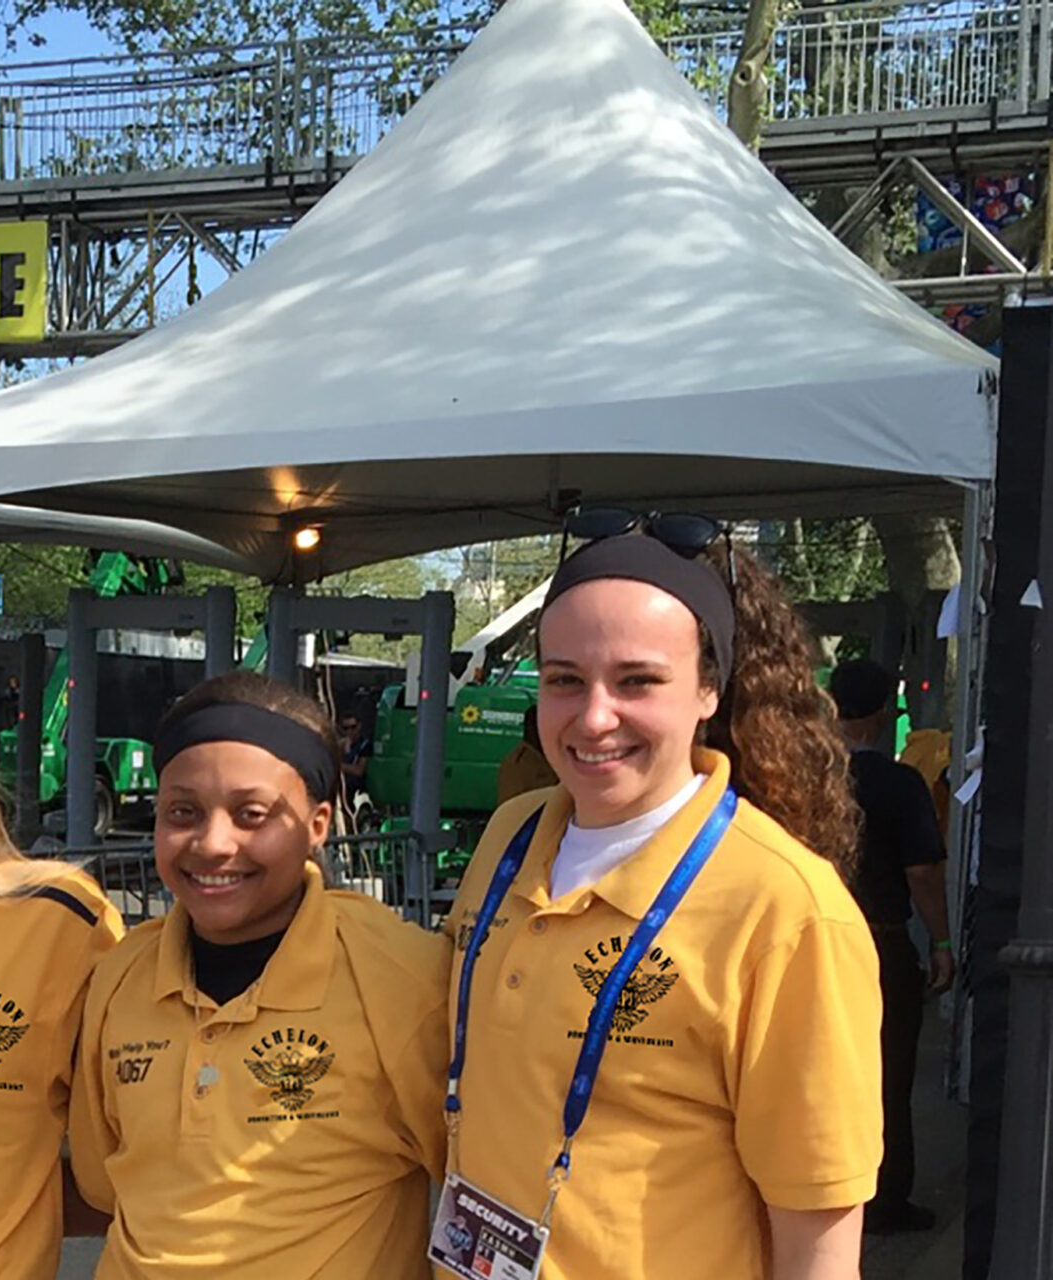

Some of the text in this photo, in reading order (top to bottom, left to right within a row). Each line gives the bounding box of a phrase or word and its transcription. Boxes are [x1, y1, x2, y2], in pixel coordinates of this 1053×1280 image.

[583, 935, 675, 972] ECHON
[250, 1027, 330, 1058] ECHELON
[456, 1193, 529, 1242] SECURITY
